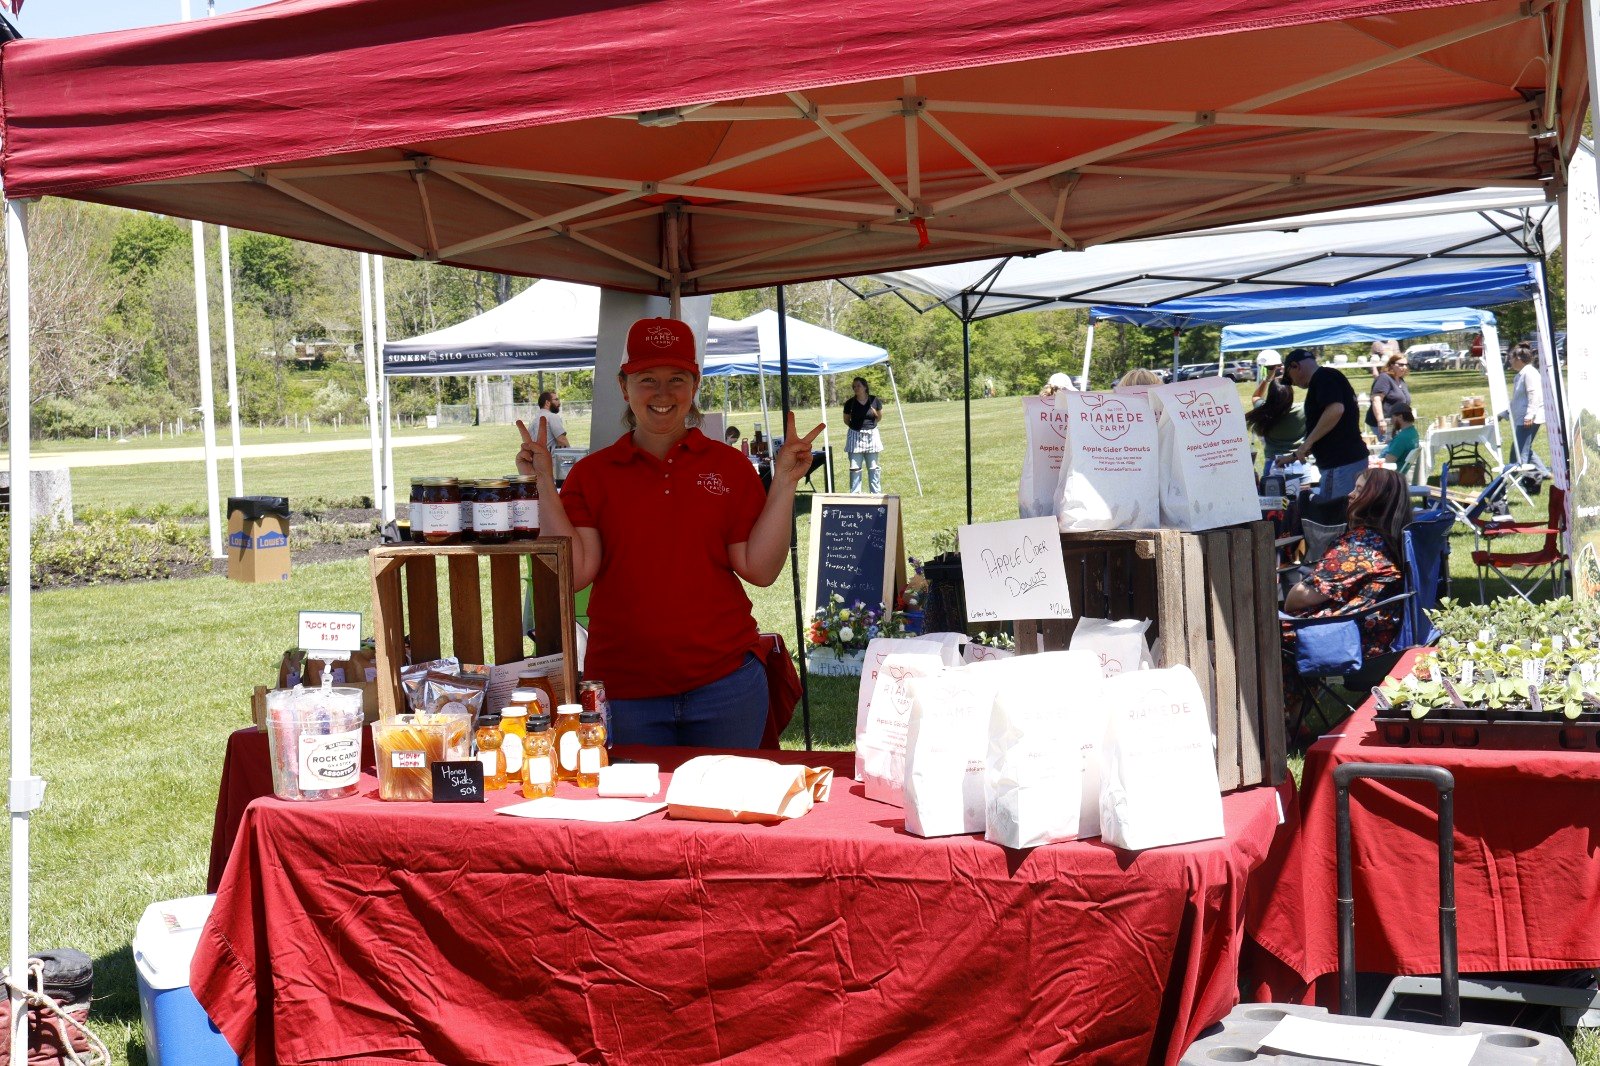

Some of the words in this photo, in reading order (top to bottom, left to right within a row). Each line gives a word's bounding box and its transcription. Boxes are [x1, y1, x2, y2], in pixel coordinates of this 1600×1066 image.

[388, 353, 427, 362] SUNKEN
[439, 352, 462, 361] SILO
[500, 351, 514, 359] NEW
[515, 350, 539, 358] JERSEY
[1080, 412, 1144, 424] RIAMEDE
[1180, 404, 1231, 420] RIAMEDE
[1100, 424, 1126, 432] FARM
[1197, 418, 1218, 428] FARM
[1082, 445, 1102, 453] Apple
[1186, 444, 1203, 452] Apple
[1203, 441, 1220, 449] Cider
[1221, 436, 1244, 445] Donuts
[259, 536, 285, 548] LOWE'S
[981, 547, 1022, 580] APPLE
[1023, 535, 1049, 564] CIDER
[1004, 568, 1048, 598] DONUTS
[329, 621, 357, 631] Candy
[321, 633, 340, 641] $1.95
[312, 755, 337, 764] ROCK
[322, 766, 355, 777] ASSORTED
[441, 765, 467, 779] Honey
